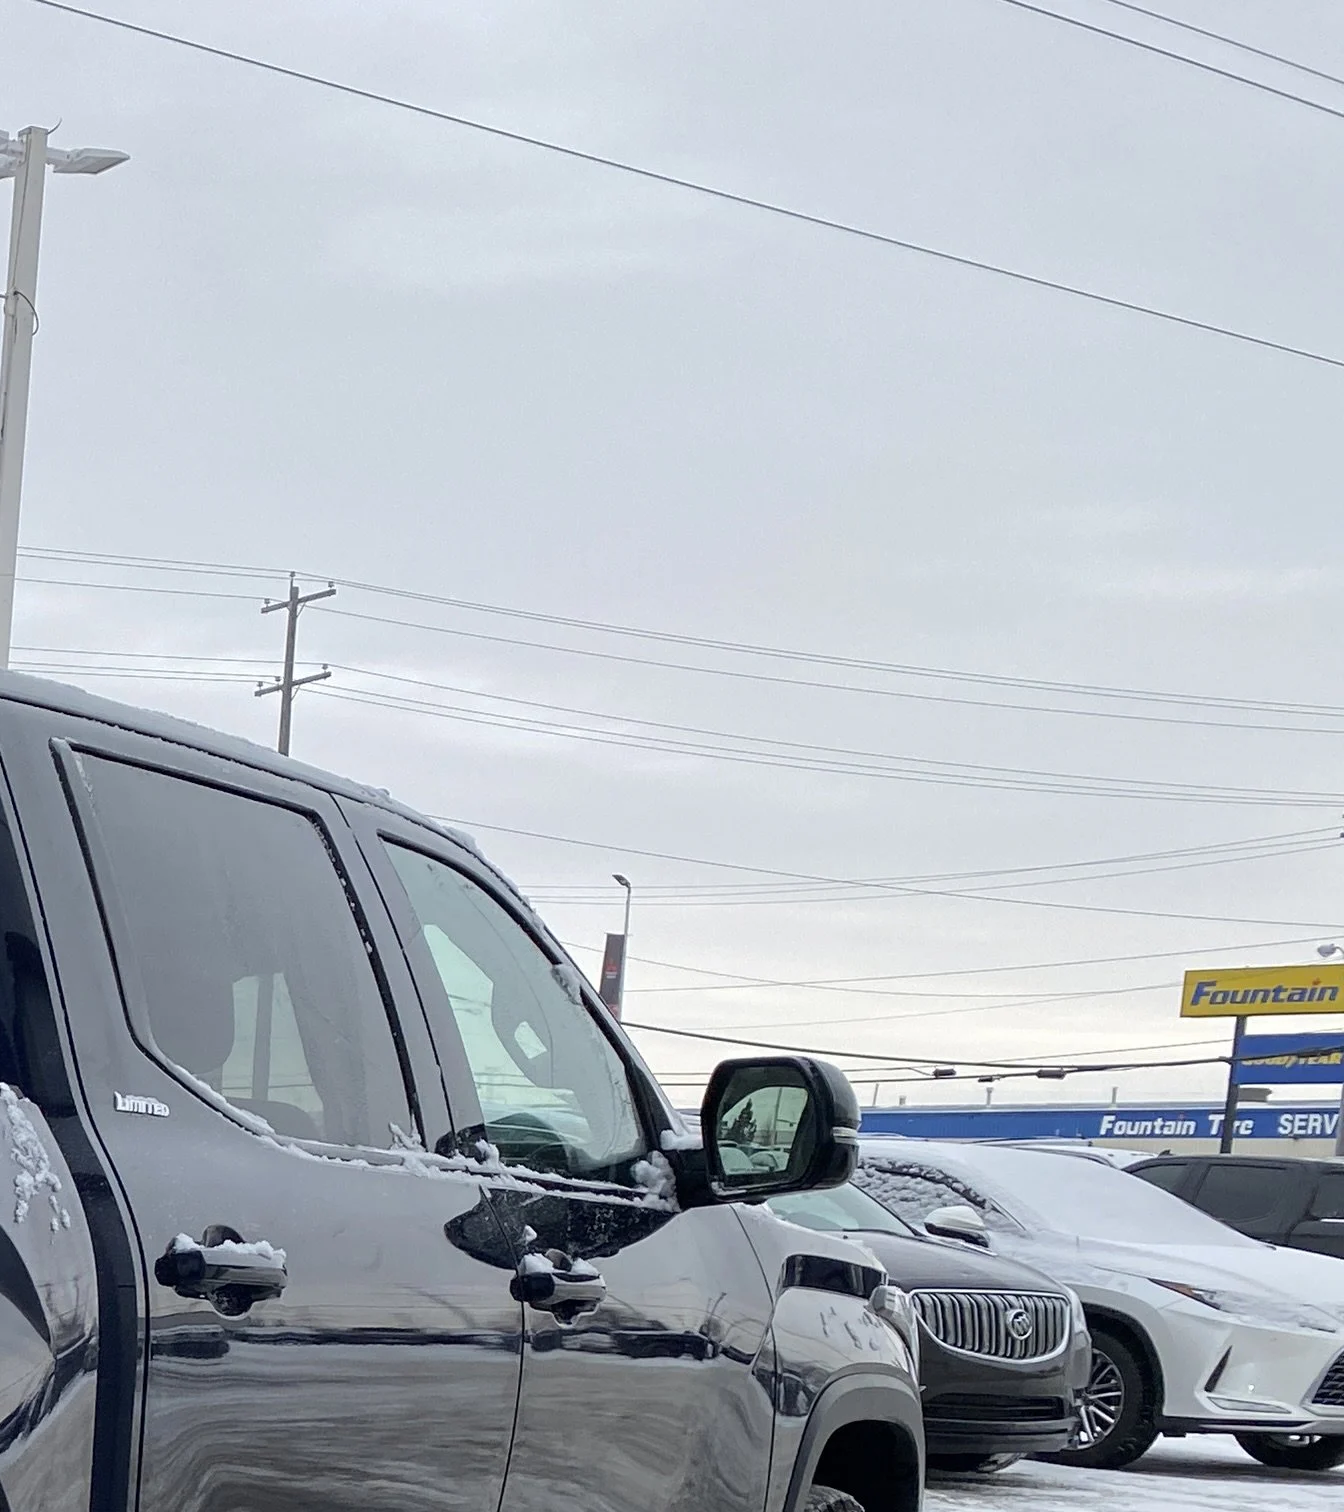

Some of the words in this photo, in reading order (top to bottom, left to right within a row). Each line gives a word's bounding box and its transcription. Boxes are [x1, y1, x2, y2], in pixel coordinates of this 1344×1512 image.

[1190, 979, 1339, 1006] Fountain
[1100, 1114, 1197, 1136] Fountain
[1208, 1113, 1254, 1136] Tre
